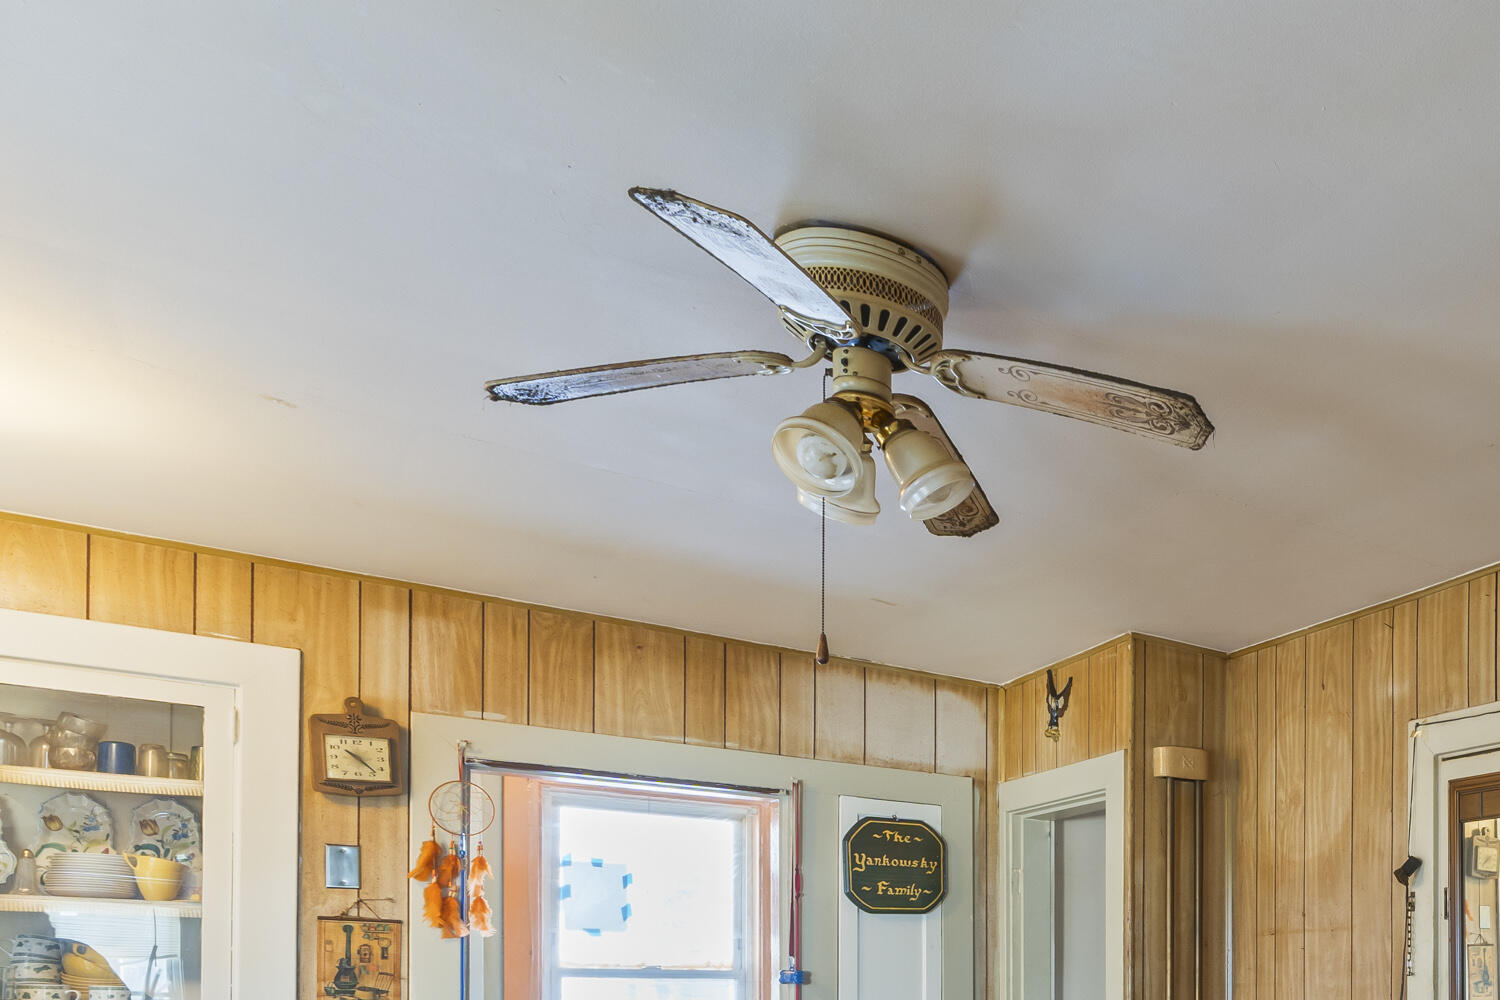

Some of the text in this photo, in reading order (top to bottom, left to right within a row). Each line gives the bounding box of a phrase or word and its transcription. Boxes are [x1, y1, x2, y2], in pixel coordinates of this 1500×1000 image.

[882, 830, 912, 843] The
[853, 852, 938, 874] Yankowsky
[877, 881, 922, 901] Family
